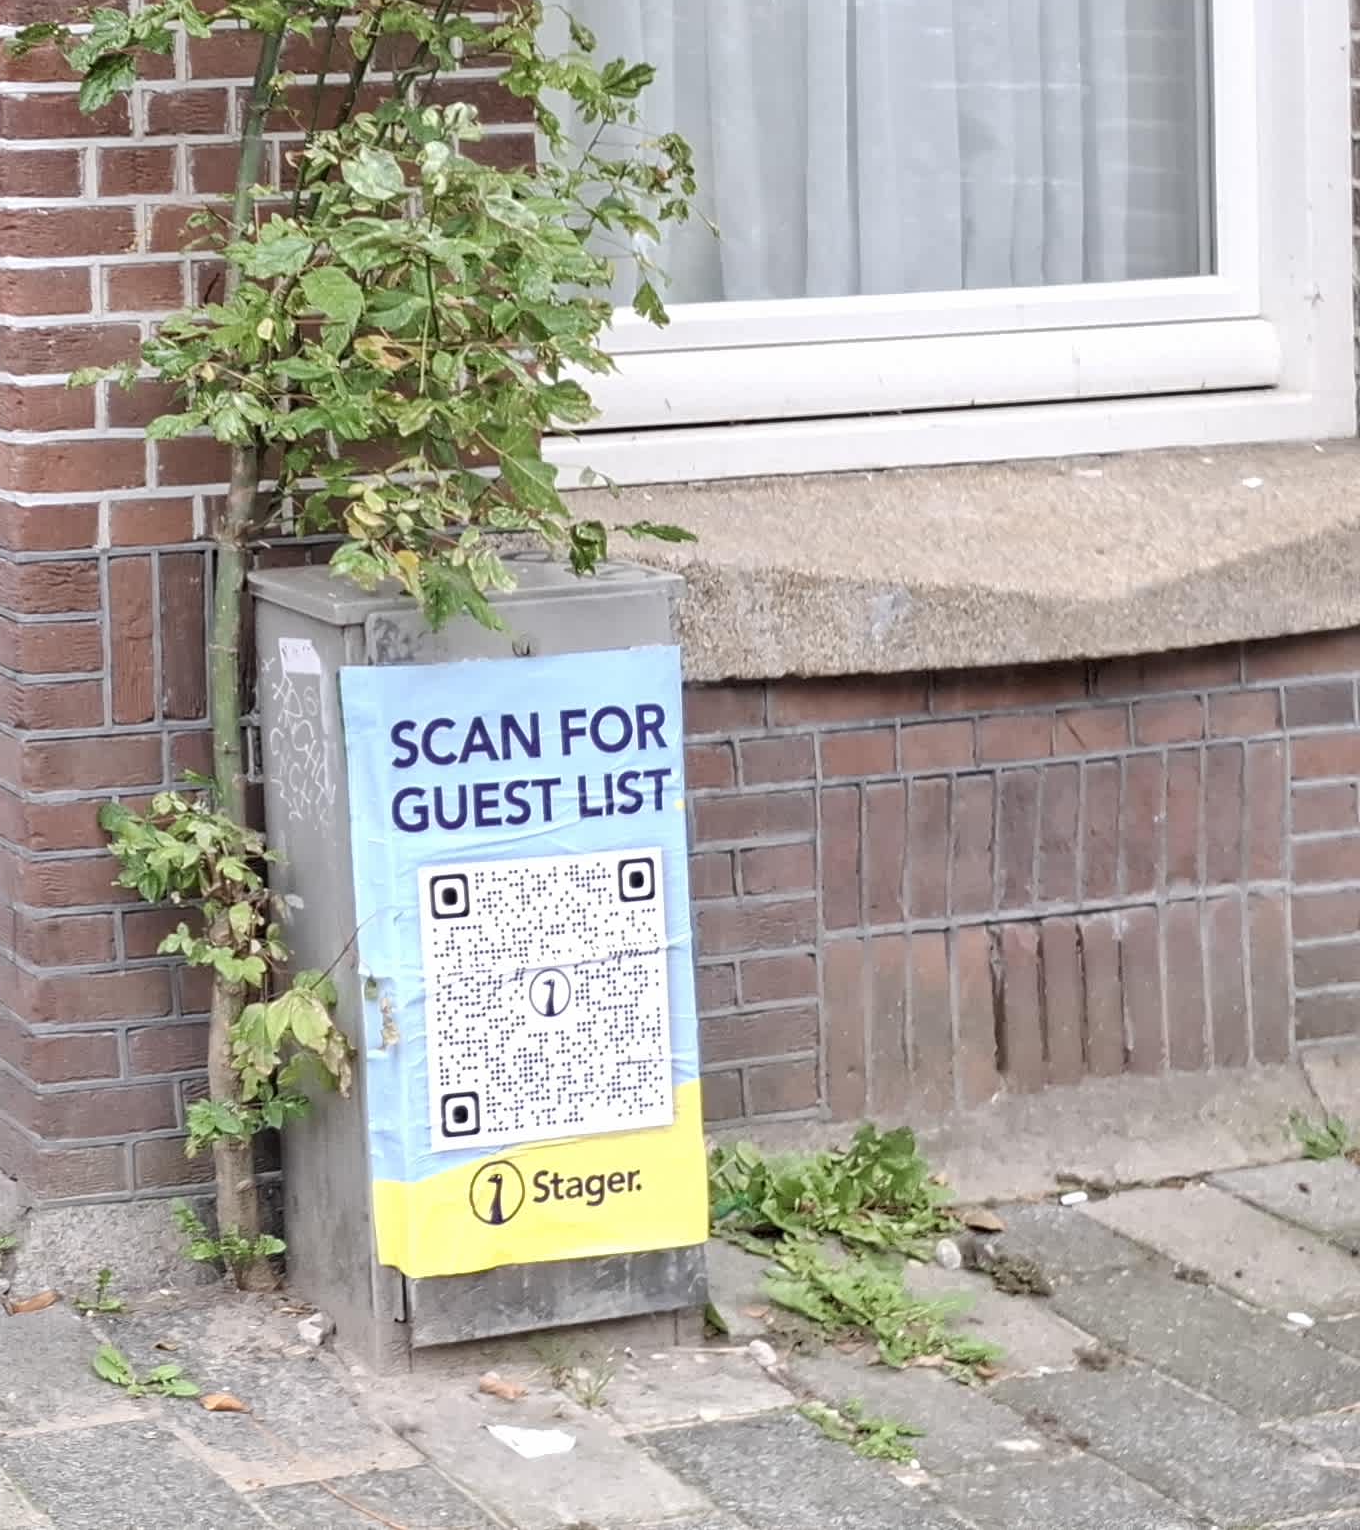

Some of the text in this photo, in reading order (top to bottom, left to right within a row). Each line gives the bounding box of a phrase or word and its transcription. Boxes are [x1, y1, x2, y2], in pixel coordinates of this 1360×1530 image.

[390, 704, 668, 769] SCAN FOR
[392, 768, 673, 833] GUEST LIST
[532, 1169, 643, 1208] Stager.
